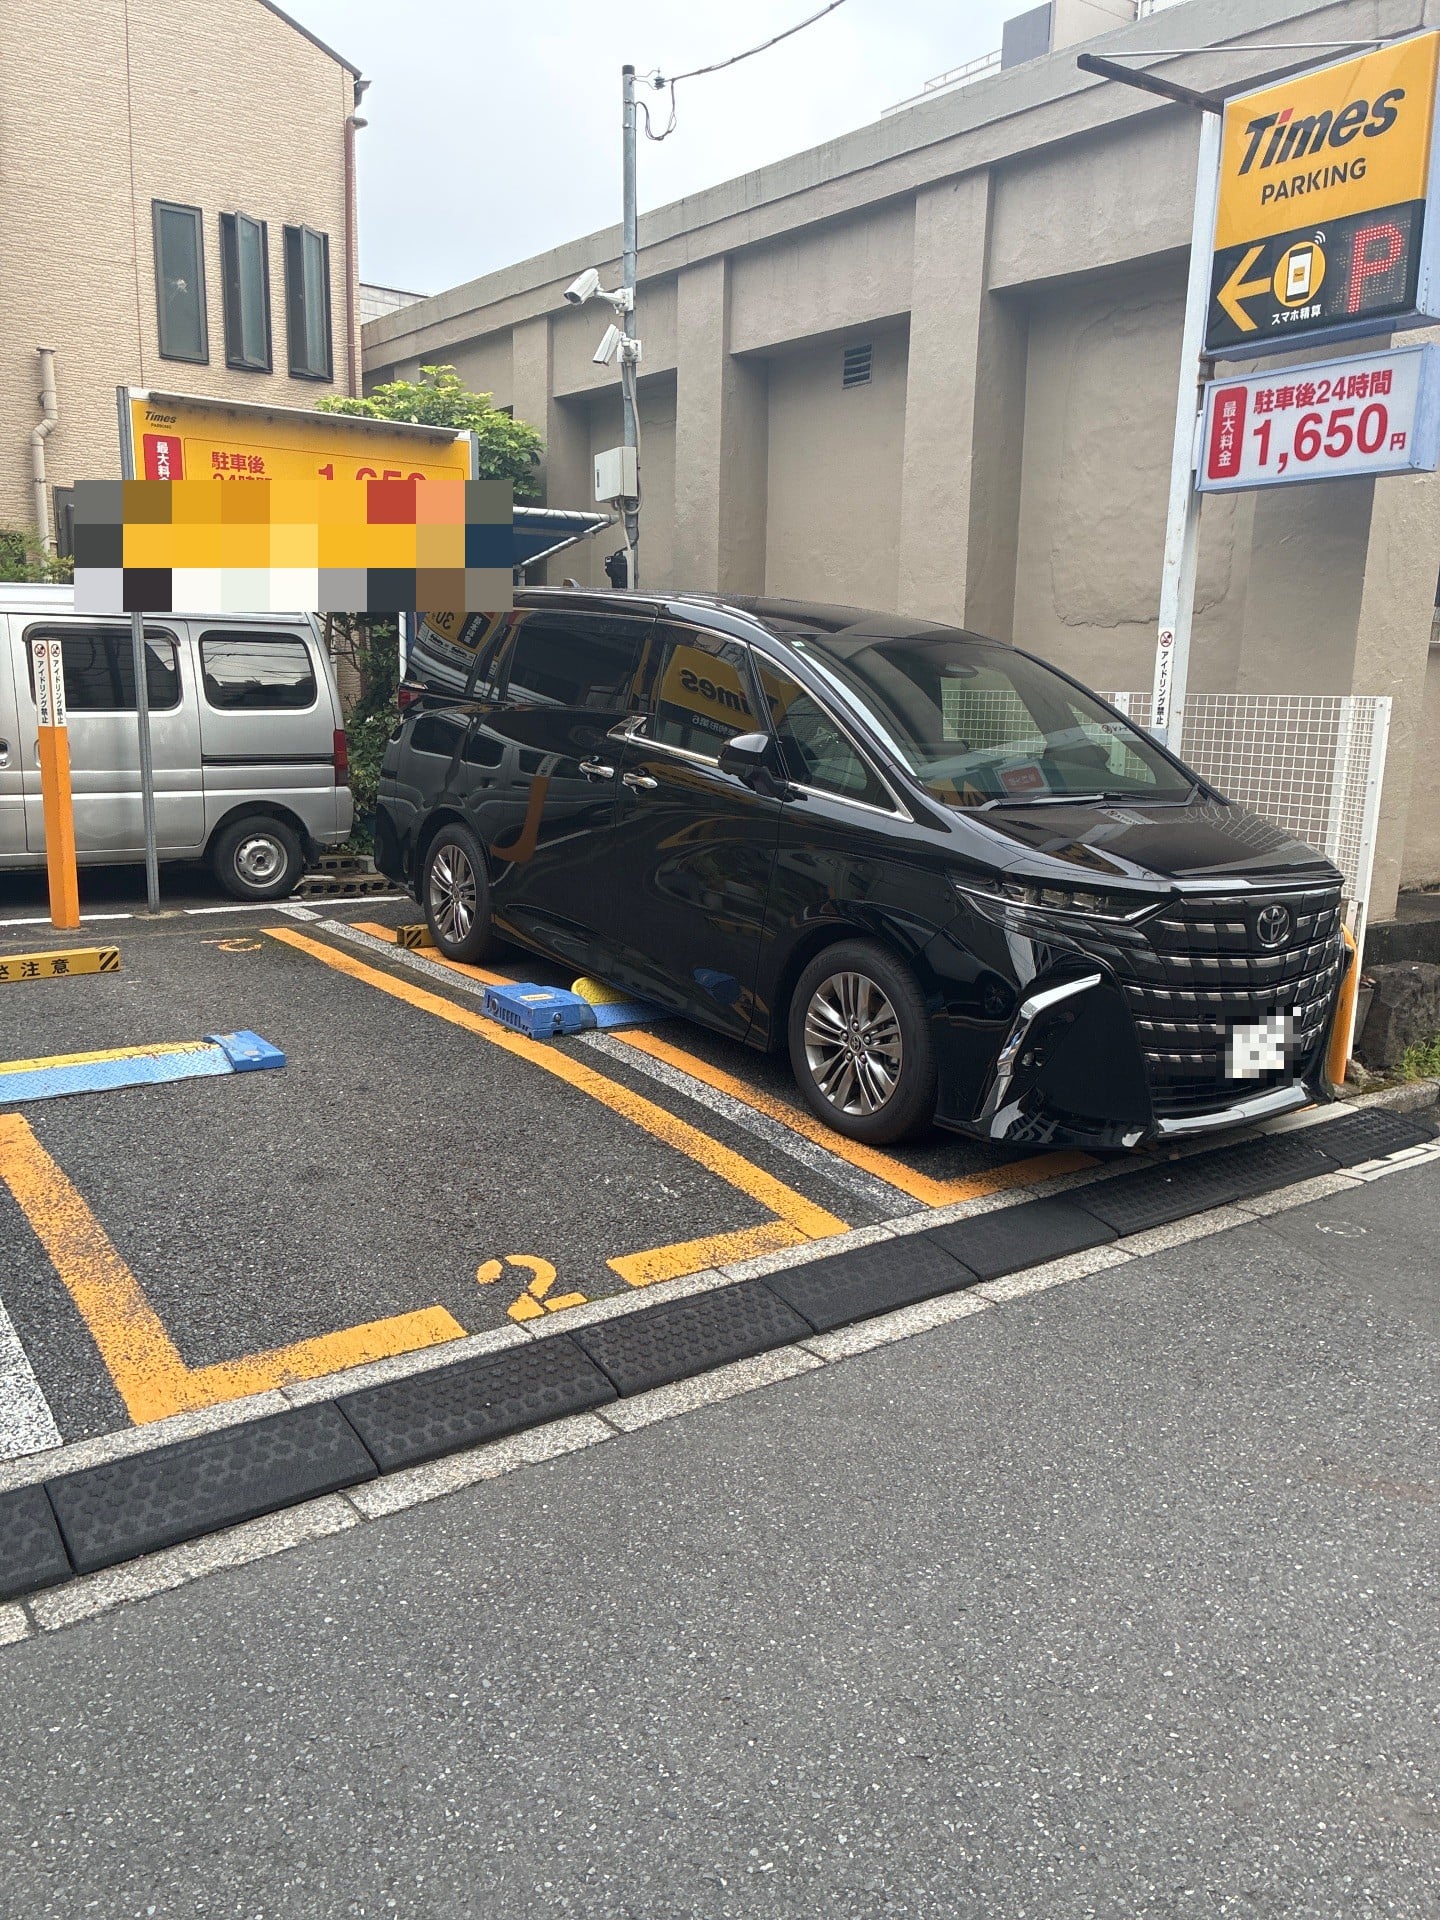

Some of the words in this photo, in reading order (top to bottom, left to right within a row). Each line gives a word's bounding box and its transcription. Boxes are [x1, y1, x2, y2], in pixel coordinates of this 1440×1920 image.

[1238, 88, 1406, 176] Times
[1261, 157, 1366, 205] PARKING
[1347, 224, 1402, 313] P
[1271, 303, 1322, 326] スマホ精算
[145, 410, 177, 424] Times
[1253, 369, 1393, 415] 駐車後24時間
[156, 441, 171, 480] 最大料
[211, 451, 266, 475] 駐車後
[1217, 400, 1237, 468] 最大料金
[37, 660, 49, 724] アイドリング禁止
[53, 660, 64, 725] アイドリング禁止
[1155, 650, 1169, 725] アイドリング禁止
[476, 1254, 588, 1322] 2
